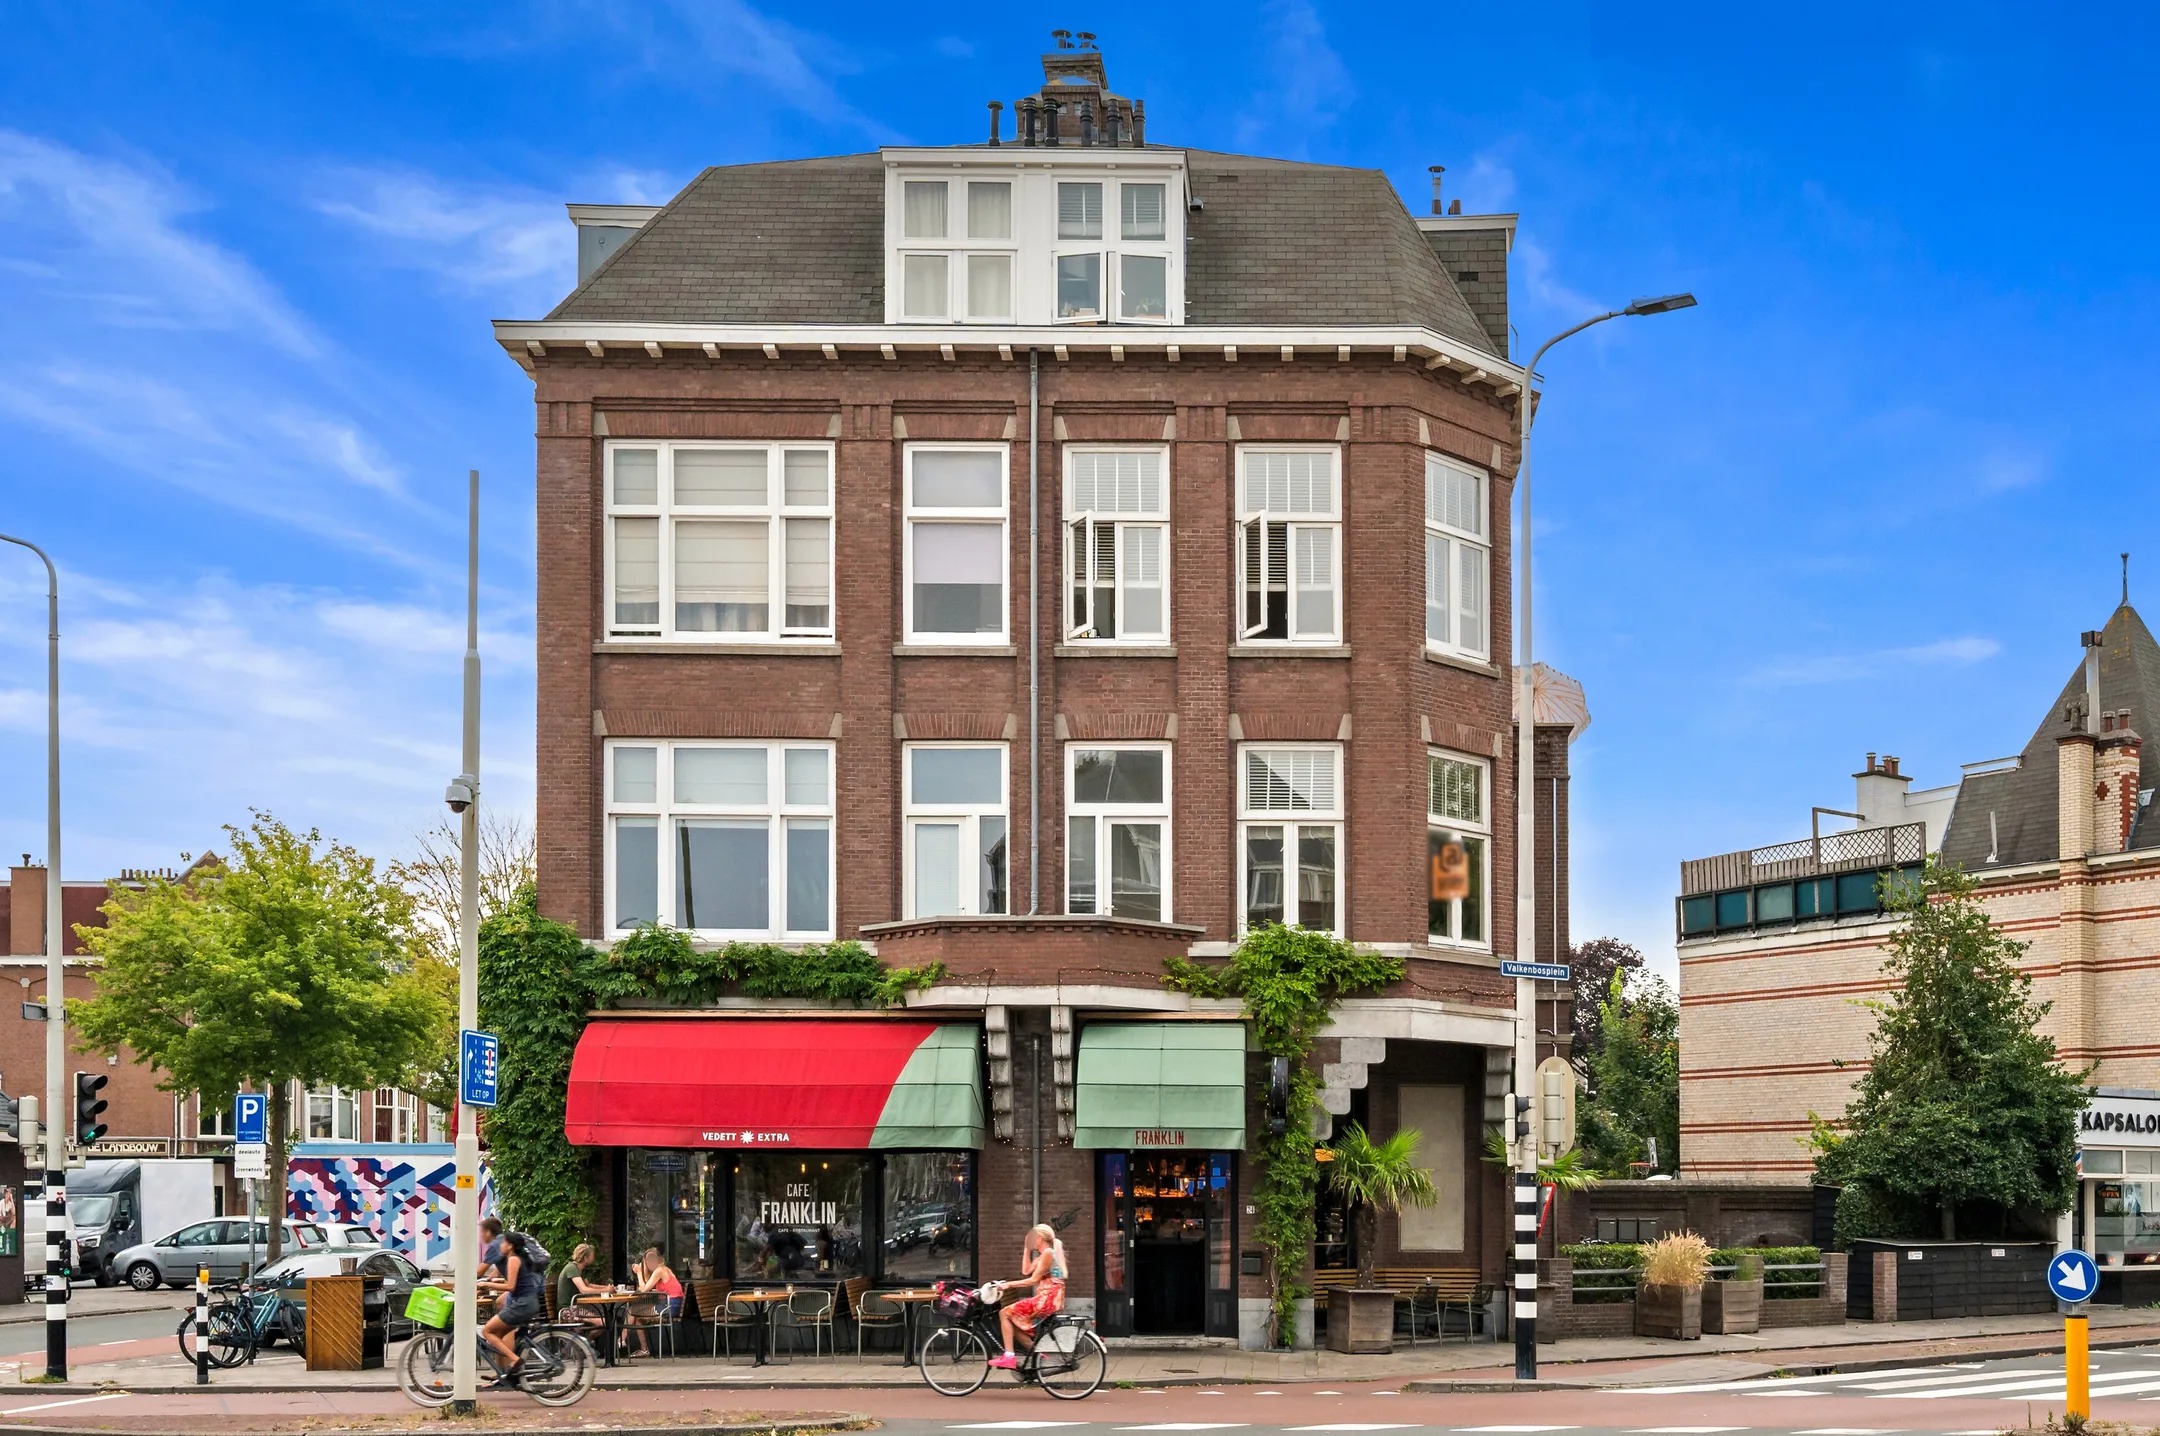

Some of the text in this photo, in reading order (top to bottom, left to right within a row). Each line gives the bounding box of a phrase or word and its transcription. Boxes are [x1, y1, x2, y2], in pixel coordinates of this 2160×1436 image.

[1506, 963, 1565, 977] Valkenbosplein
[471, 1089, 490, 1099] LET OP
[242, 1099, 259, 1124] P
[2081, 1111, 2160, 1133] KAPSALO
[702, 1132, 790, 1142] VEDETT EXTRA
[1135, 1130, 1185, 1145] FRANKLIN
[102, 1143, 159, 1153] LANDBOUW
[786, 1183, 810, 1197] CAFE
[761, 1201, 836, 1224] FRANKLIN
